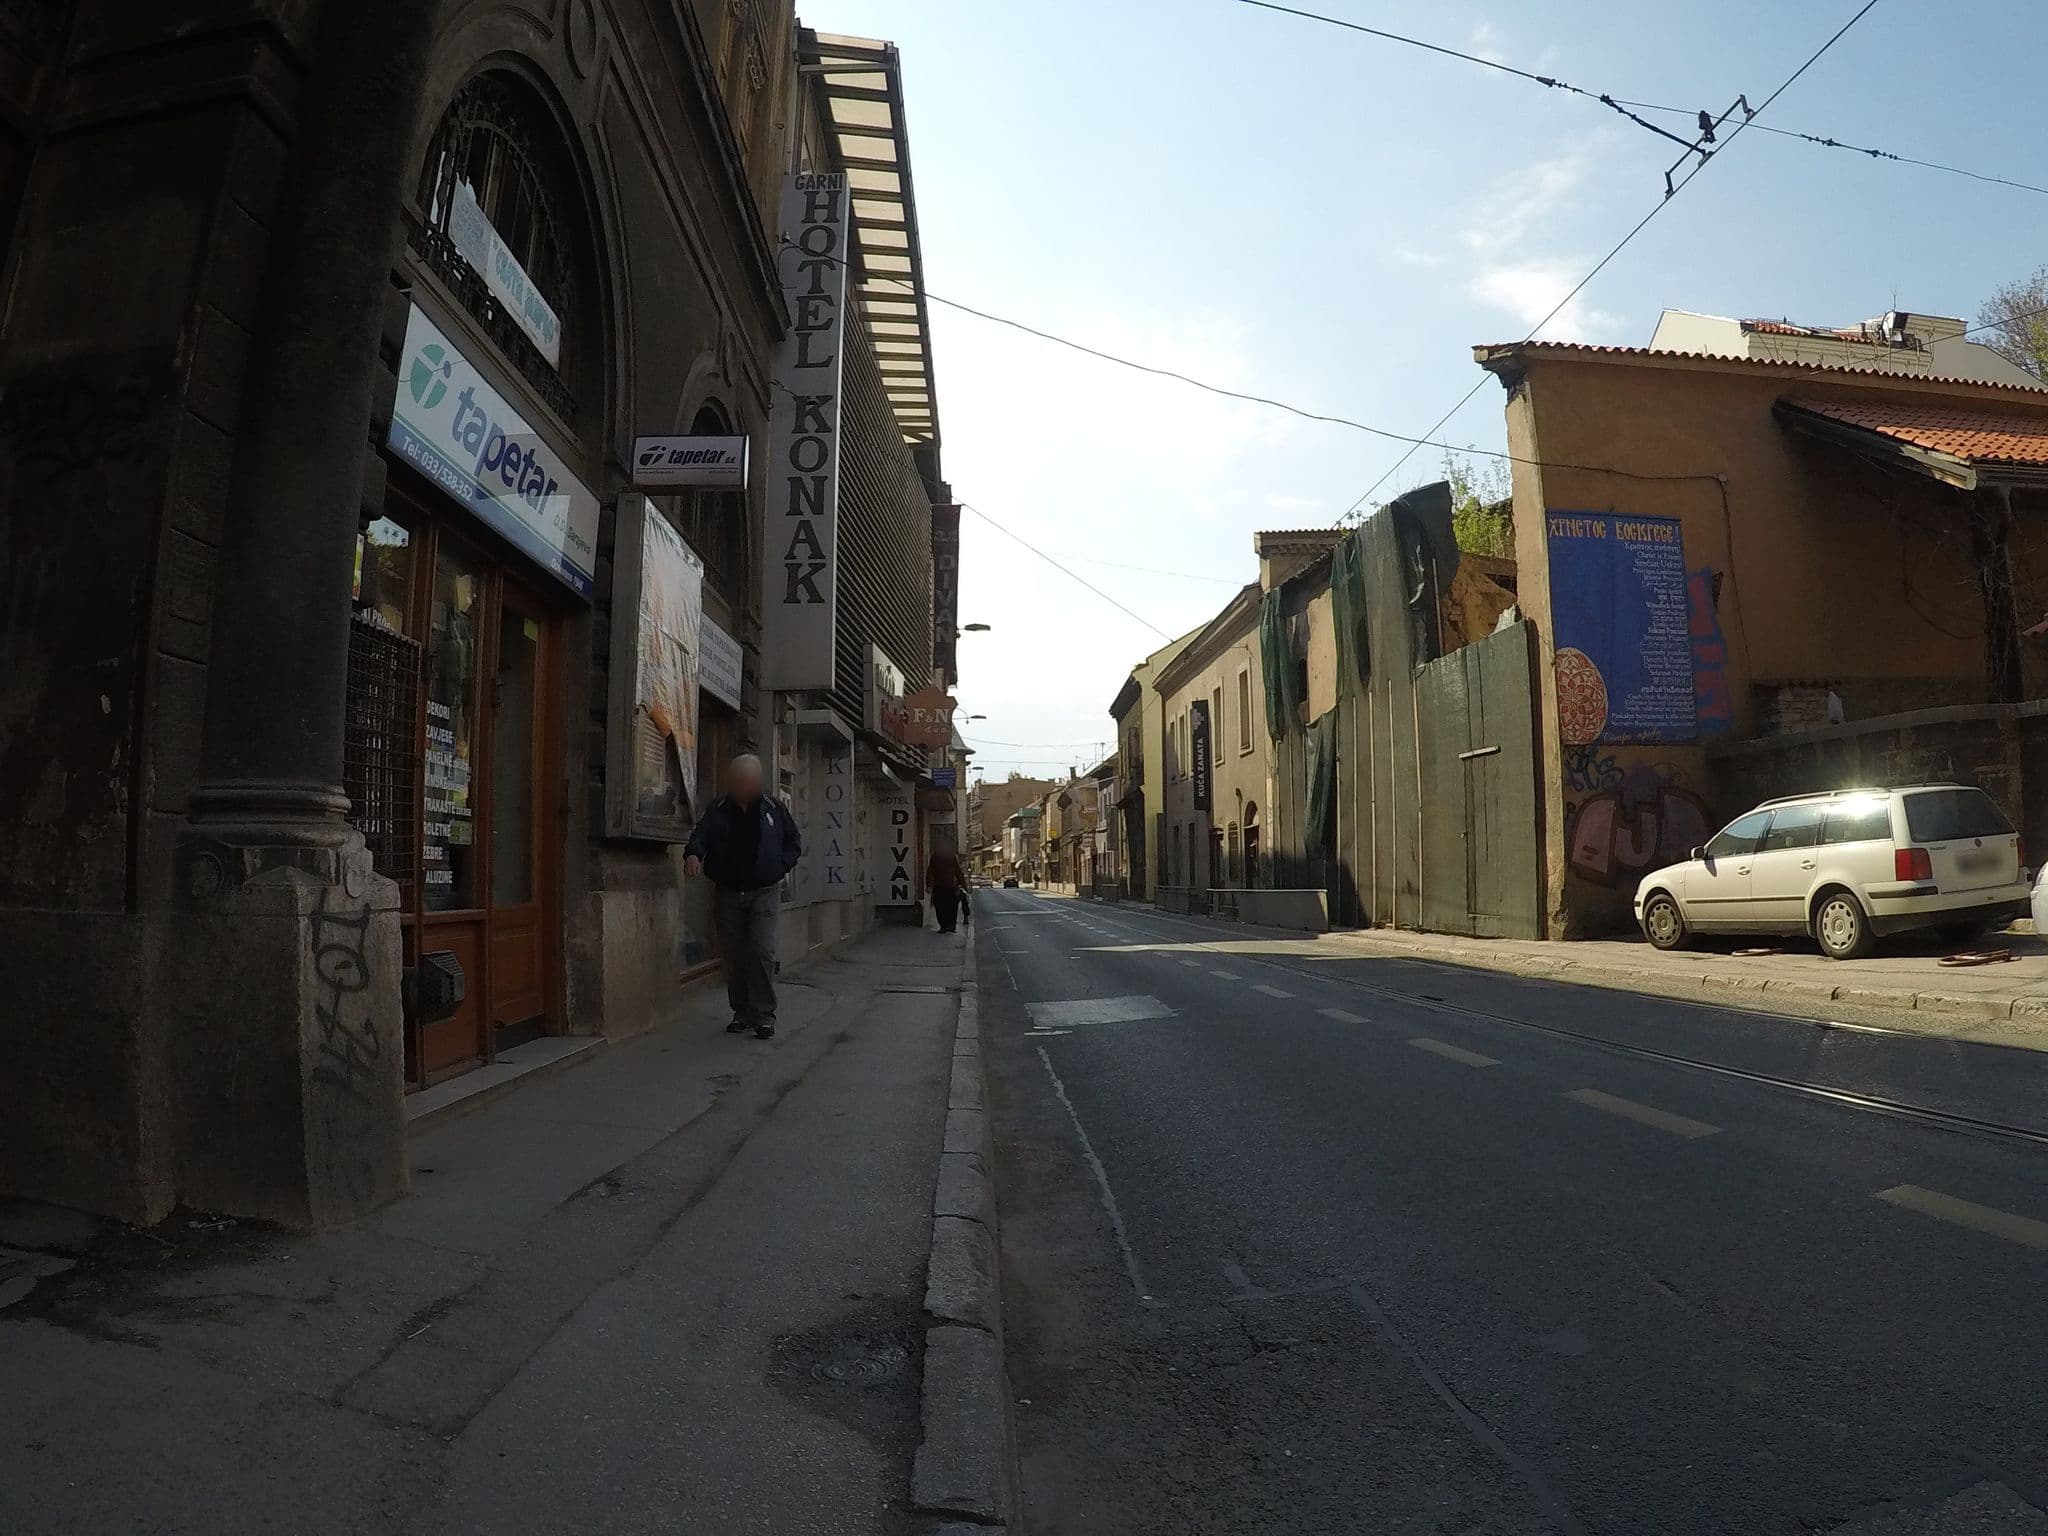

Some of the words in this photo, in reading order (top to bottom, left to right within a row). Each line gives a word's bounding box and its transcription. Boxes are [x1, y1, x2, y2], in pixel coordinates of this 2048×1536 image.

[794, 174, 843, 191] GARNI
[793, 190, 842, 369] HOTEL
[402, 435, 421, 461] Tel:
[421, 450, 474, 502] 033/538-352
[452, 386, 558, 515] tapetar
[667, 449, 727, 466] tapetar
[783, 394, 833, 604] KONAK
[913, 707, 950, 724] F&N
[825, 756, 845, 885] KONAK
[889, 809, 910, 901] DIVAN
